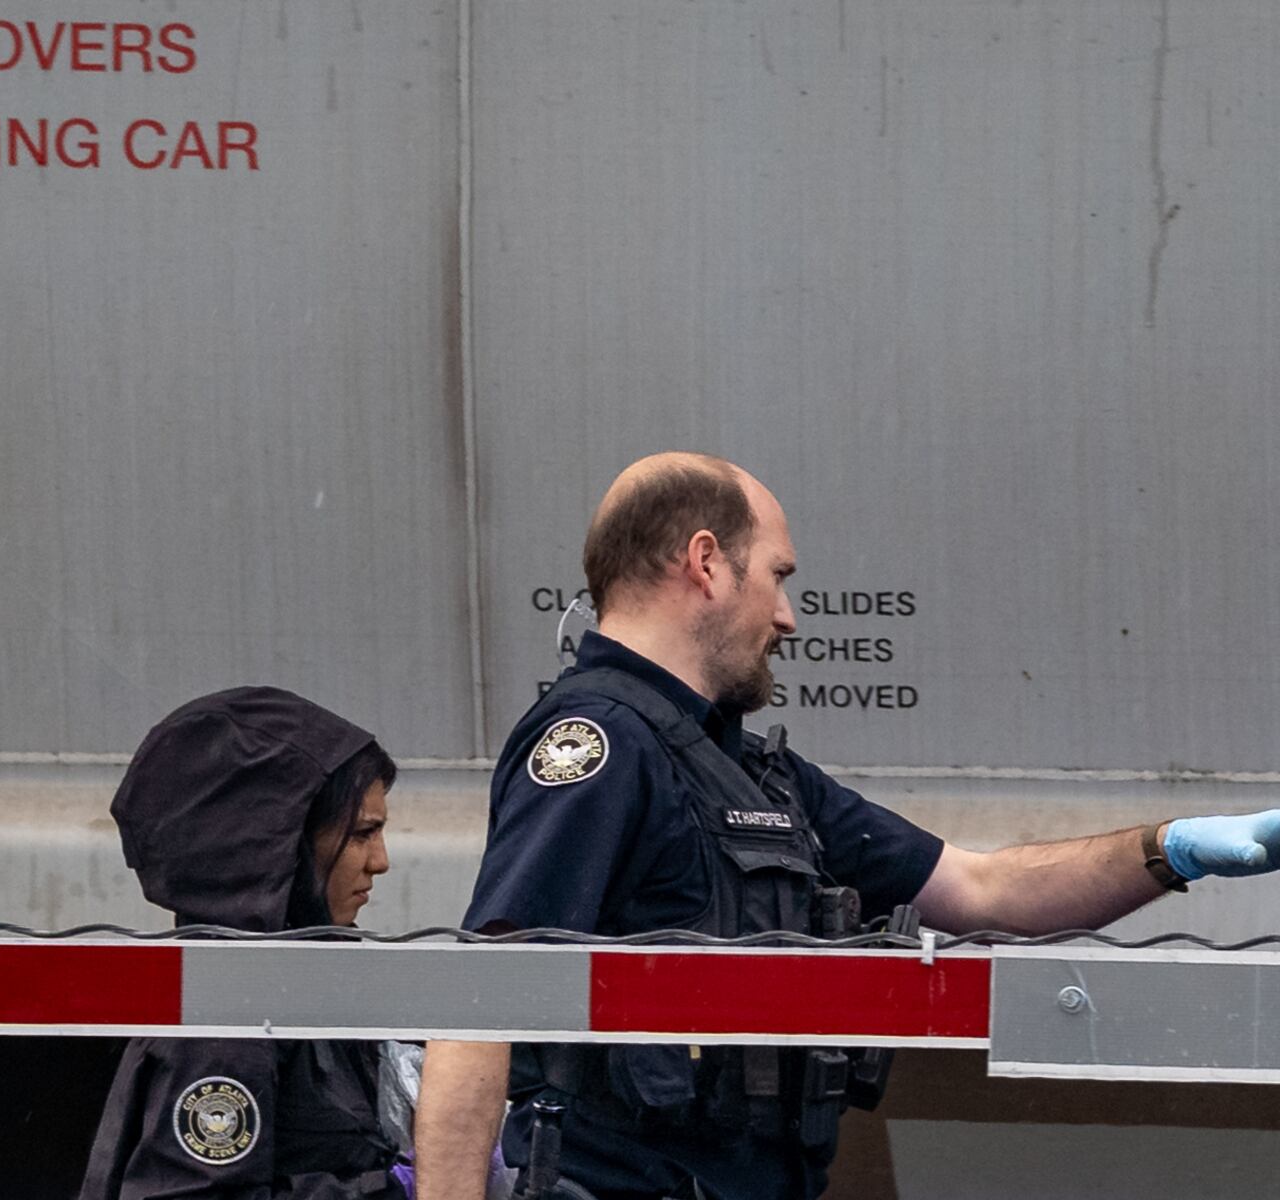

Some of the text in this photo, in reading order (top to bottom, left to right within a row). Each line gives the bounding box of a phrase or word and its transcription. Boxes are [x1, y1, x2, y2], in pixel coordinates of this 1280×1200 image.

[123, 119, 260, 170] CAR
[800, 590, 916, 616] SLIDES
[768, 637, 894, 662] ATCHES
[800, 685, 918, 709] MOVED
[552, 724, 568, 737] OF
[537, 766, 586, 780] POLICE
[201, 1085, 213, 1094] OF
